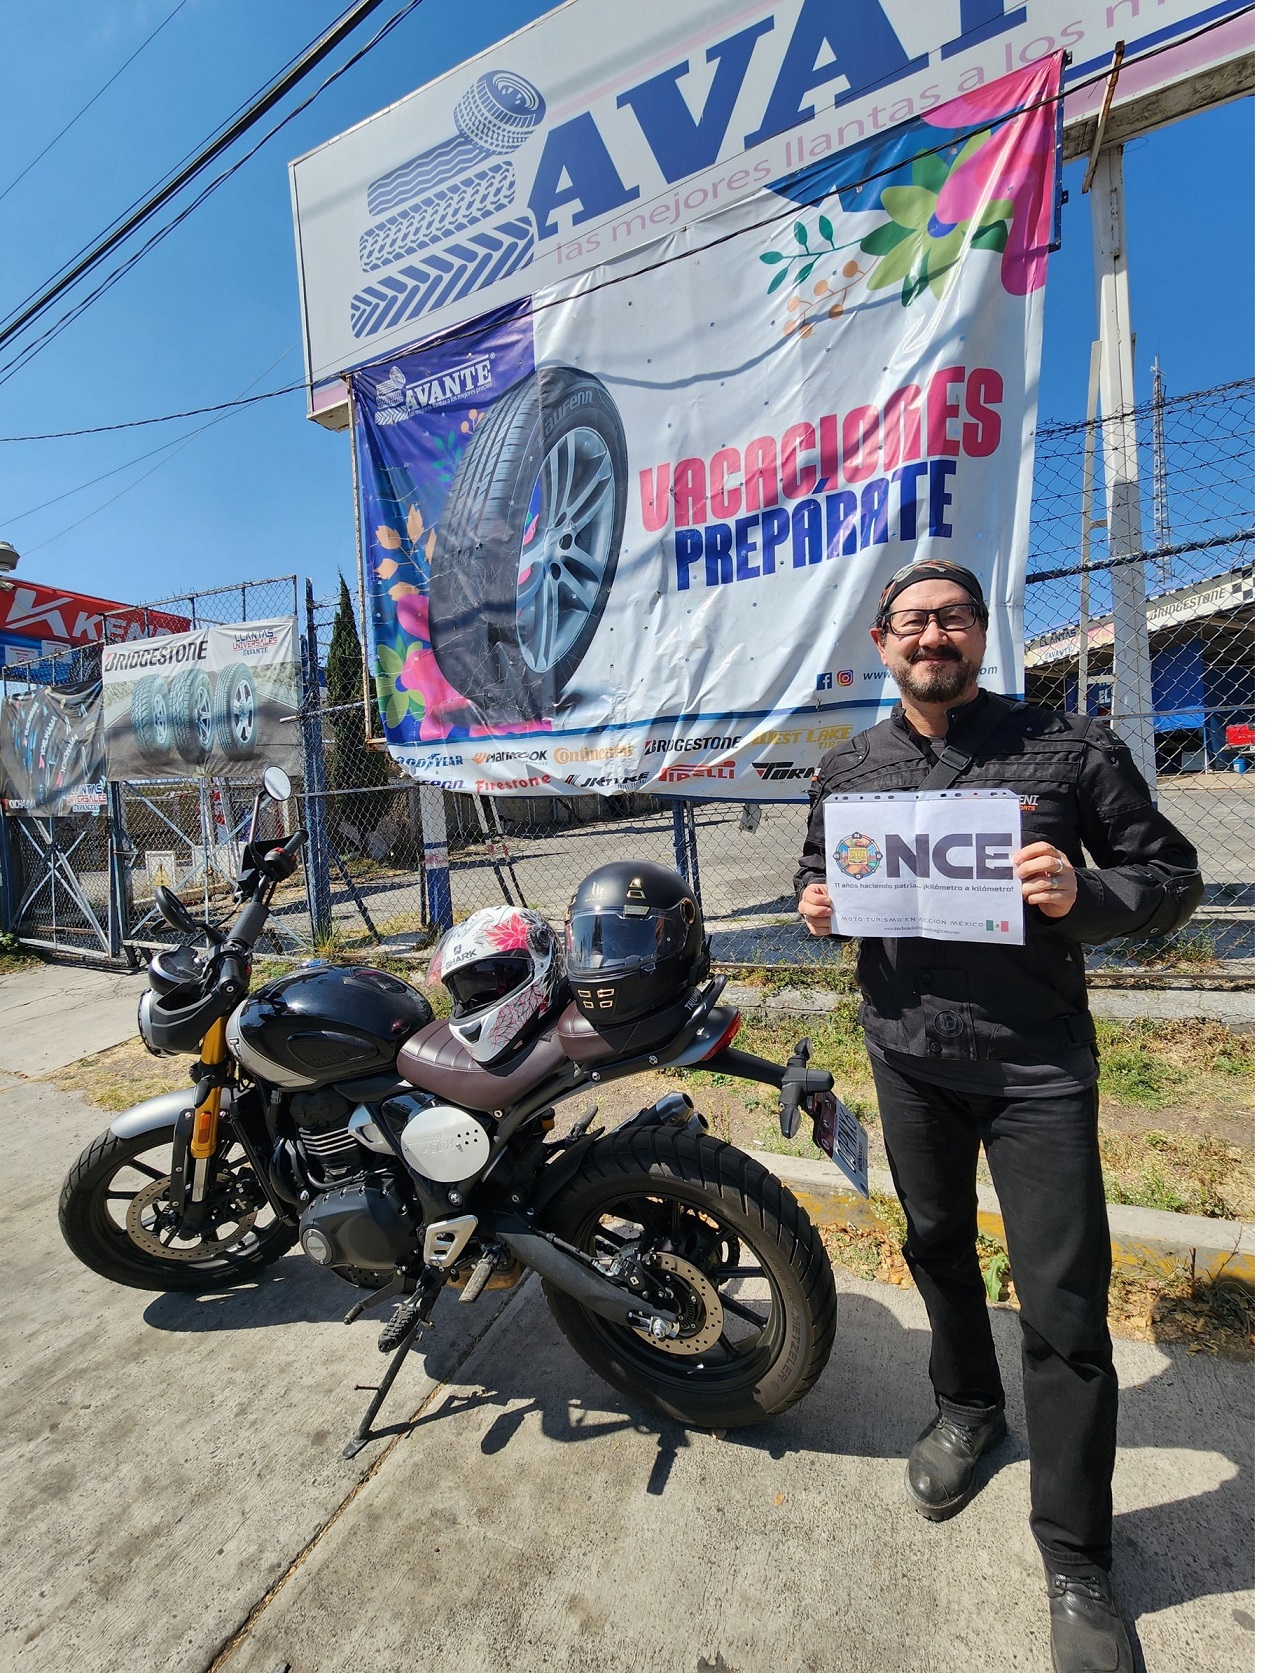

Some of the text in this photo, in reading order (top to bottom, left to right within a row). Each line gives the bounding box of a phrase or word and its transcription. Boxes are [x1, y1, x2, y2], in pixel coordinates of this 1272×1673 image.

[556, 231, 601, 265] las
[611, 159, 772, 242] mejores
[784, 84, 941, 168] llantas
[957, 67, 984, 93] a
[1005, 20, 1085, 72] los
[405, 360, 492, 412] AVANTE
[457, 388, 476, 400] mejores
[476, 382, 493, 394] precios
[638, 366, 1004, 532] VACACIONES
[674, 460, 957, 591] PREPÁRATE
[1149, 588, 1227, 620] BRIDGESTONE
[233, 637, 277, 650] UNIVERSALES
[235, 630, 274, 642] LLANTAS
[104, 640, 208, 673] BRIDGESTONE
[805, 726, 852, 743] LAKE
[553, 741, 633, 764] Continental
[475, 774, 551, 794] Firestone
[971, 885, 1014, 893] kilómetro!
[445, 949, 477, 969] SHARK
